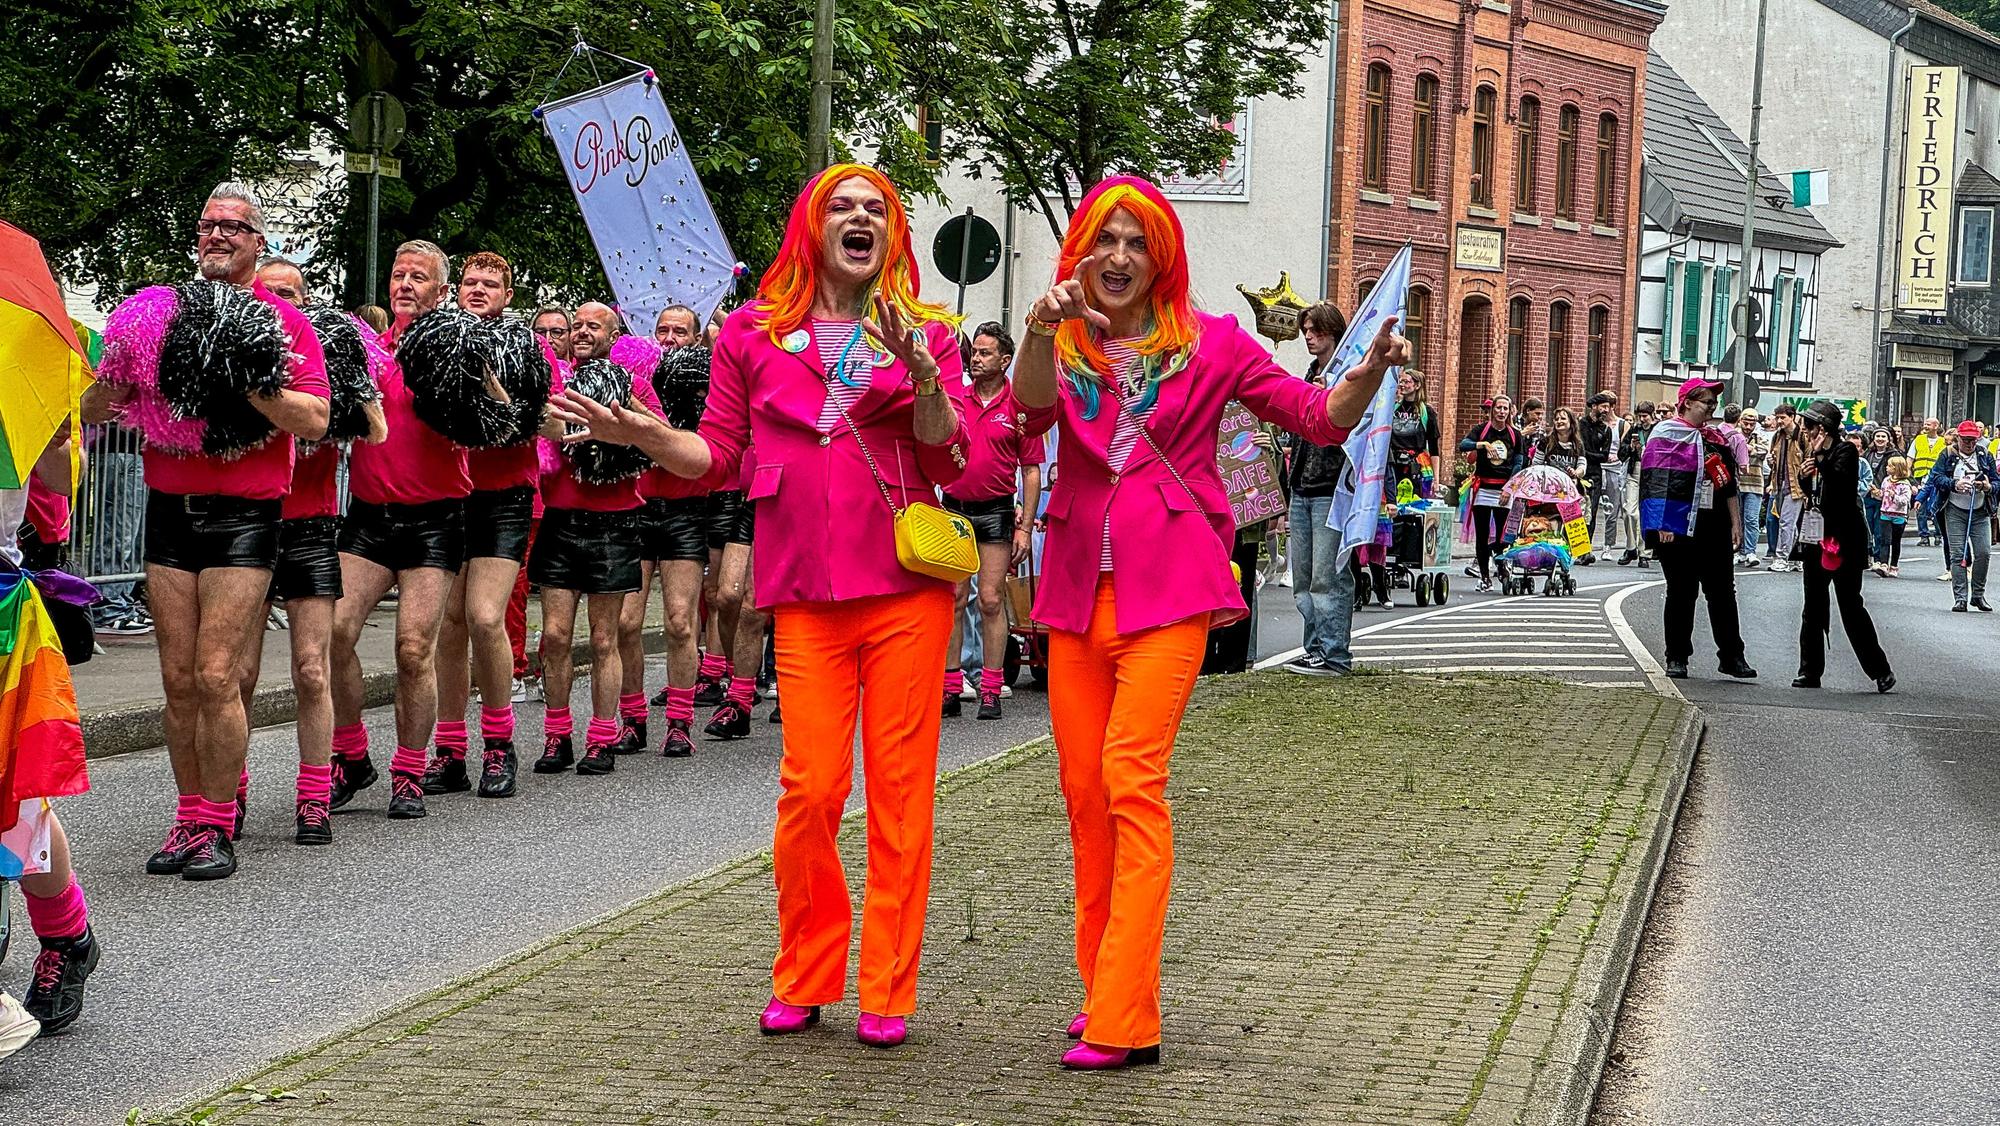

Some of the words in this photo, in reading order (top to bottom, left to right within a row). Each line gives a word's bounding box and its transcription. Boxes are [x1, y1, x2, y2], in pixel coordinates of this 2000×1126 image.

[574, 120, 627, 194] Pink
[625, 115, 680, 188] Poms
[1910, 71, 1943, 279] FRIEDRICH
[1231, 489, 1284, 526] PACE
